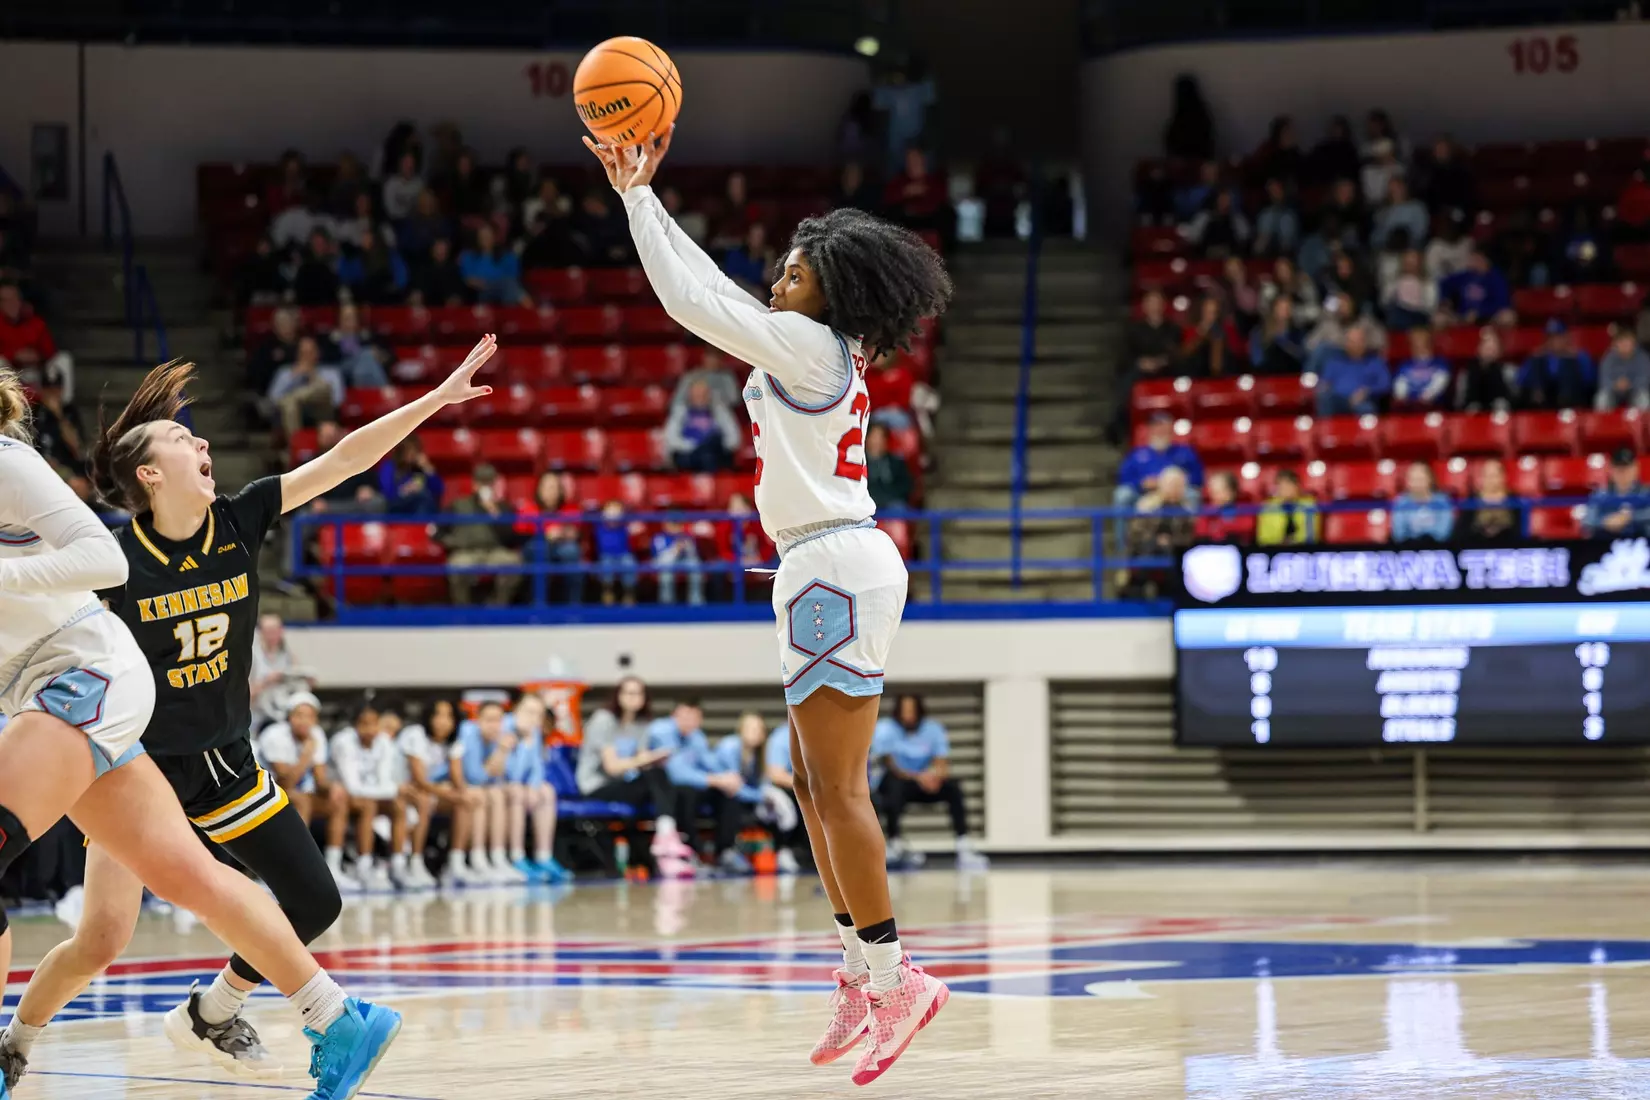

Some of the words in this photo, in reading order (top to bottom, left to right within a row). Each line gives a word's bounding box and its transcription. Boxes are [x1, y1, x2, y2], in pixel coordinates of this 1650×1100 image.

[1504, 35, 1580, 74] 105
[525, 61, 571, 98] 10
[1458, 547, 1570, 589] TECH
[137, 572, 249, 622] KENNESAW
[172, 612, 230, 662] 12
[167, 649, 229, 688] STATE
